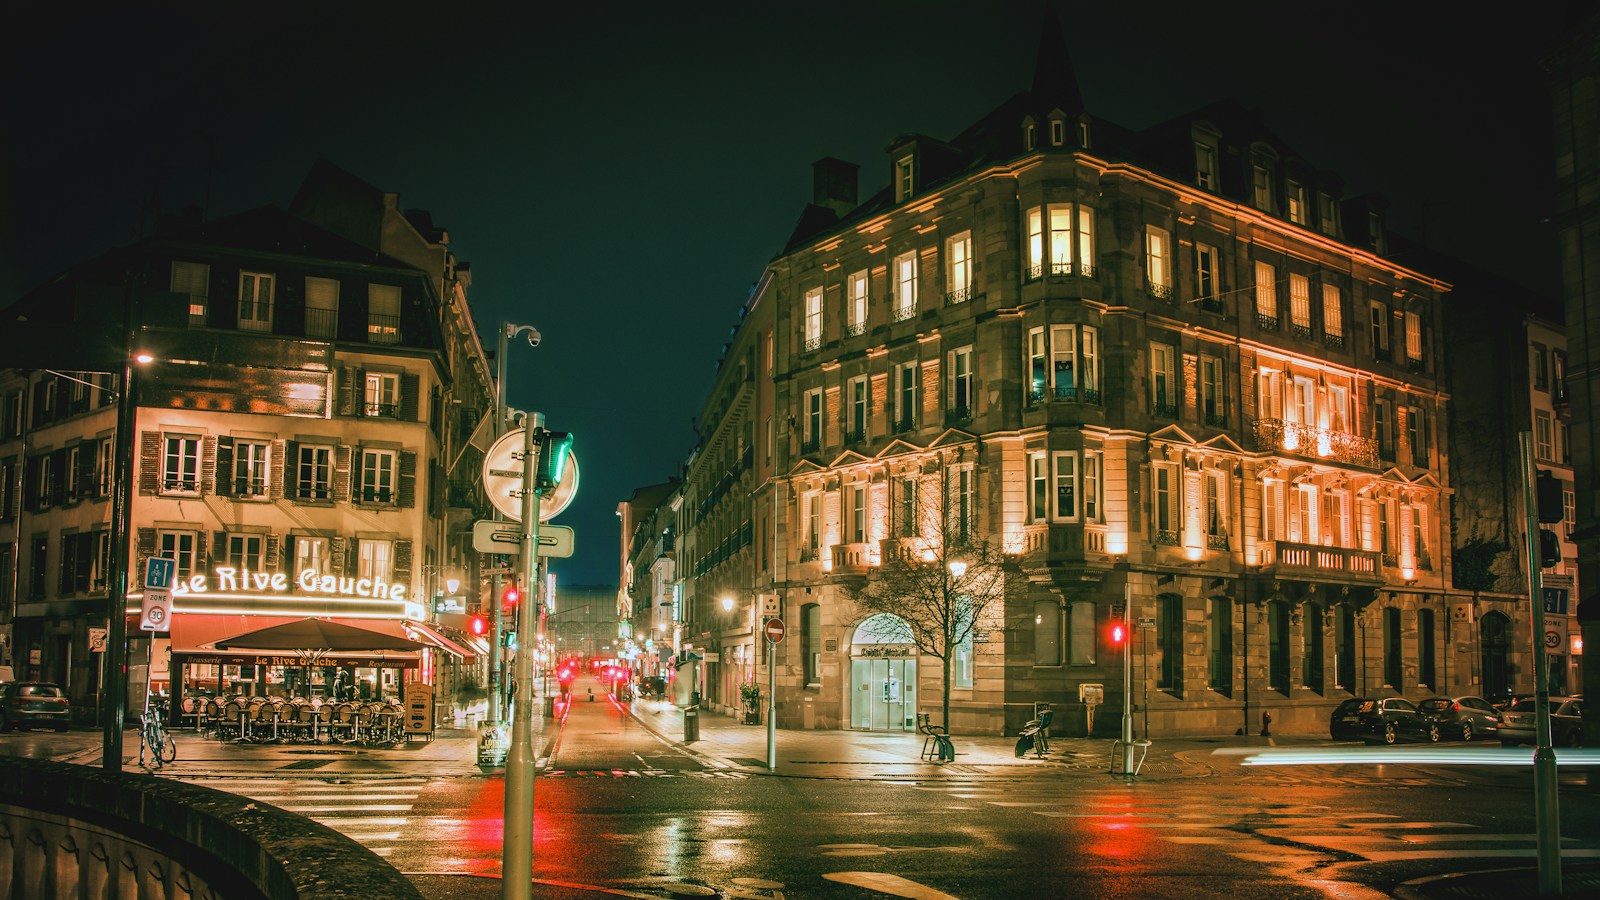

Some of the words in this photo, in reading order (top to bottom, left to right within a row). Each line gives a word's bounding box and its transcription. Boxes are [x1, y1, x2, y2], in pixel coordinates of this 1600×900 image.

[172, 574, 208, 595] Le
[215, 566, 287, 591] Rive
[299, 568, 406, 600] Gauche
[150, 594, 167, 602] ZONE
[151, 610, 162, 620] 30
[1546, 635, 1558, 644] 30
[186, 656, 222, 664] Brasserie
[254, 655, 268, 665] Le
[271, 656, 296, 666] Rive
[299, 657, 338, 667] Guche
[368, 660, 407, 668] Restaurant
